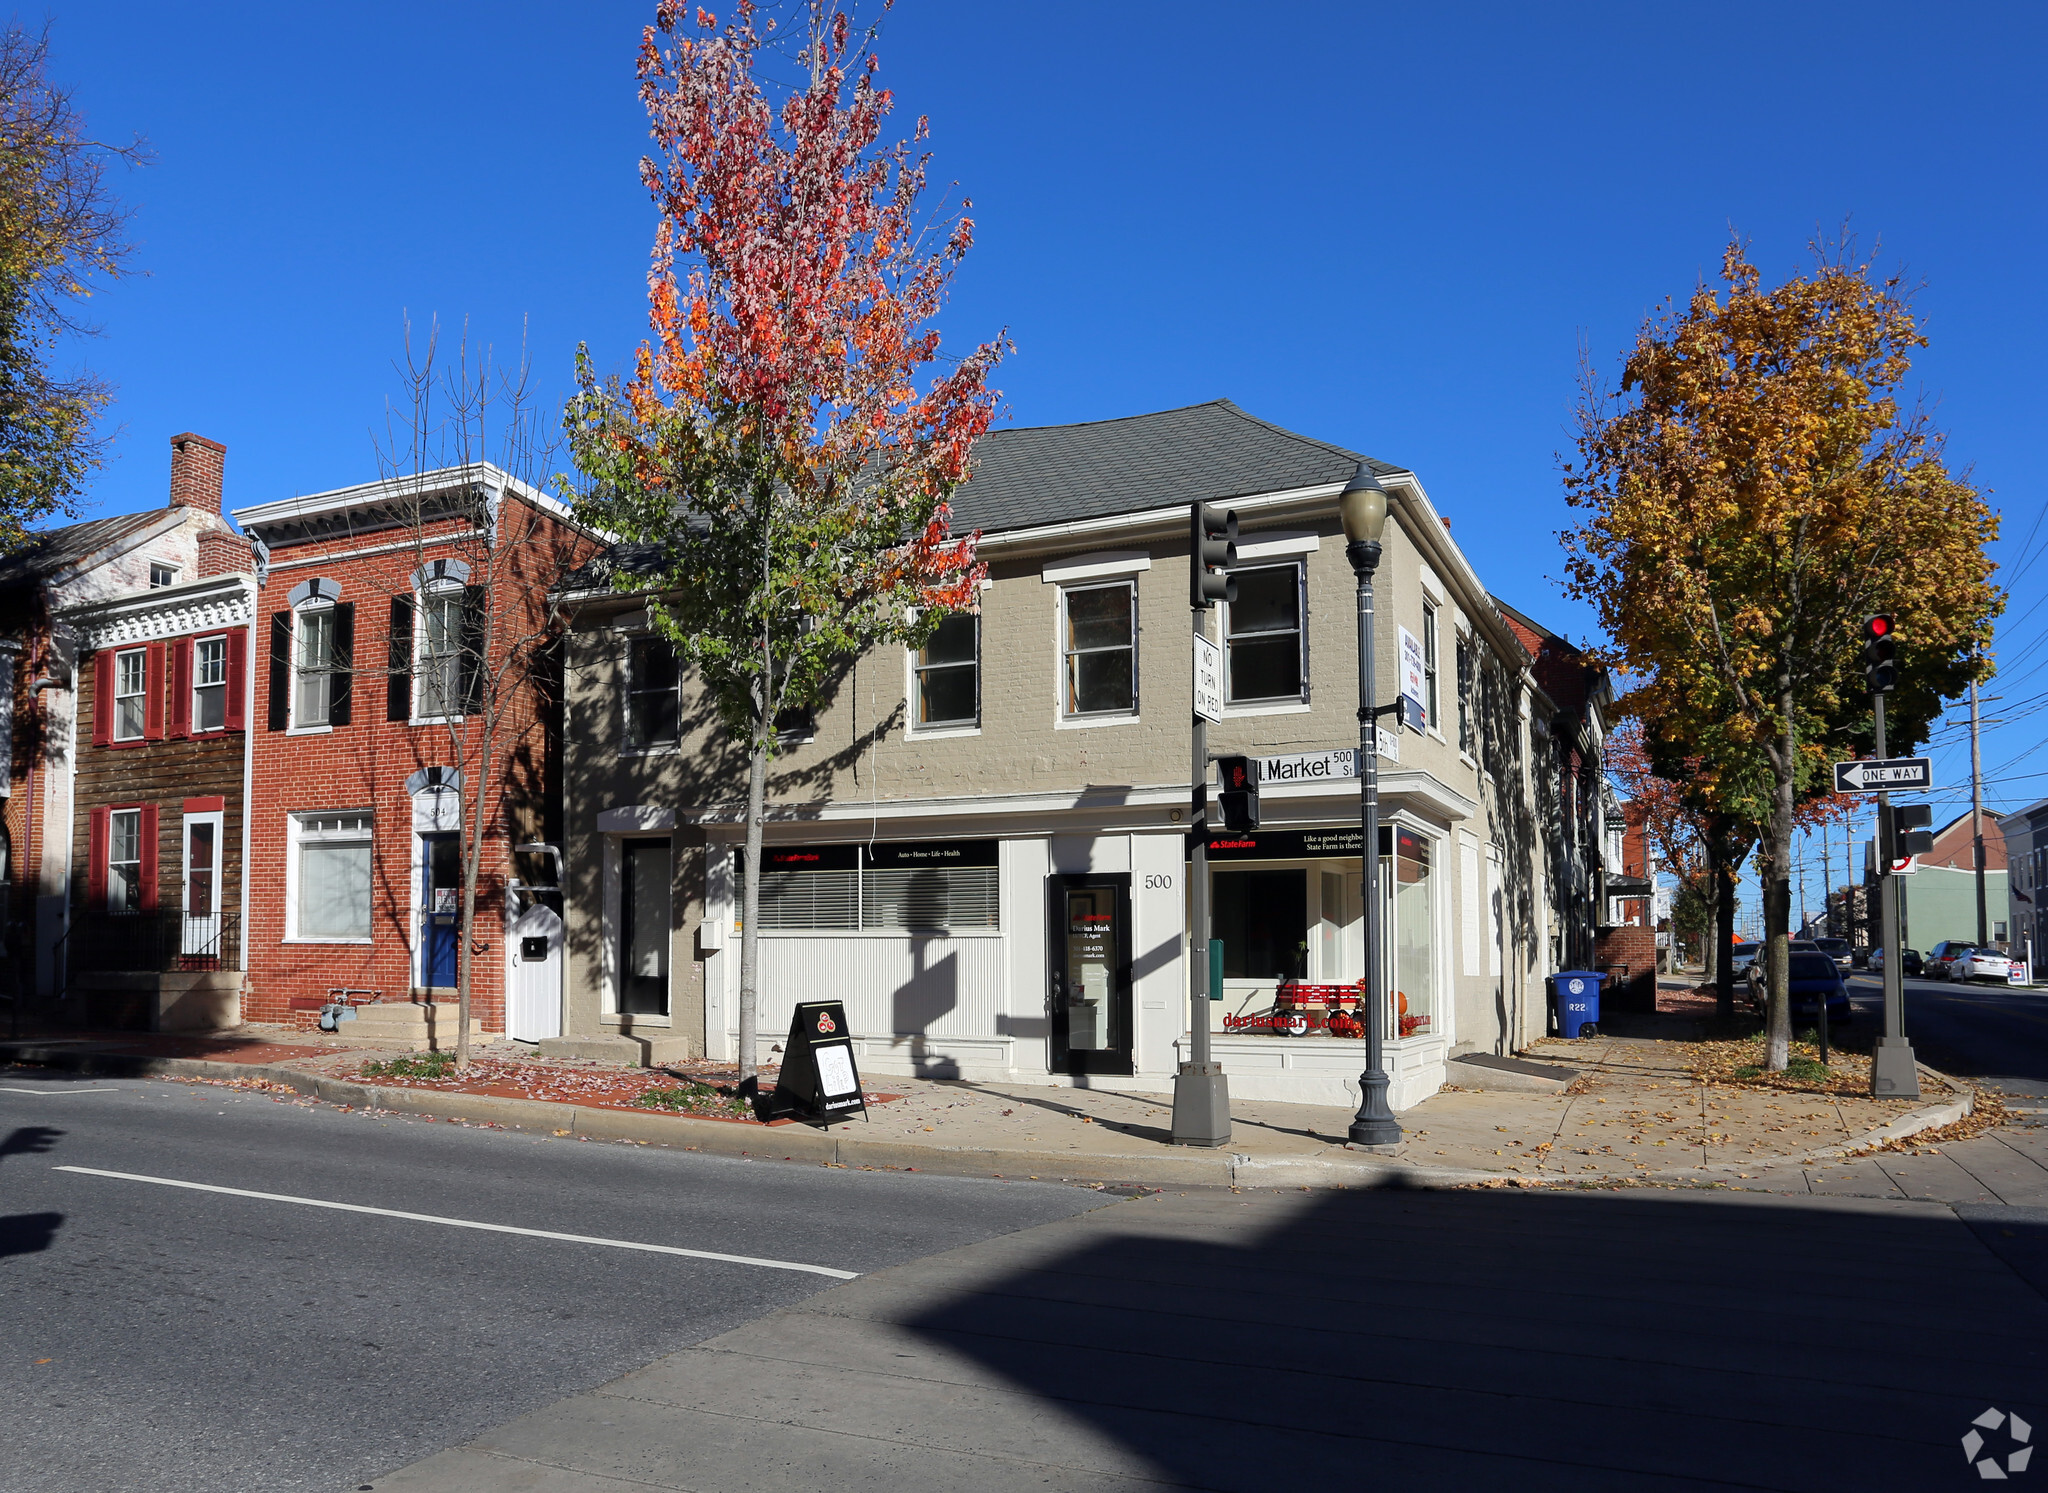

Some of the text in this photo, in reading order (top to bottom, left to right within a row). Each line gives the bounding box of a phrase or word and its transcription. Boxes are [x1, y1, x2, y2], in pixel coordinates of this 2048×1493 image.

[1203, 648, 1213, 667] NO
[1200, 669, 1216, 691] TURN
[1197, 690, 1219, 713] ON RED
[1333, 751, 1352, 763] 500
[1268, 756, 1331, 781] Market
[1343, 765, 1353, 777] St
[1862, 767, 1919, 782] ONE WAY
[430, 807, 446, 818] 504
[1304, 835, 1317, 843] Like
[1322, 835, 1338, 844] good
[1307, 843, 1322, 851] State
[912, 850, 928, 858] Home
[931, 850, 941, 858] Life
[943, 849, 961, 857] Health
[1145, 874, 1172, 890] 500
[437, 895, 456, 904] RENT
[1072, 924, 1111, 932] Darius Mark
[1568, 1003, 1586, 1012] R22
[1223, 1011, 1354, 1030] dariusmark.com
[825, 1098, 861, 1110] dariusmark.com
